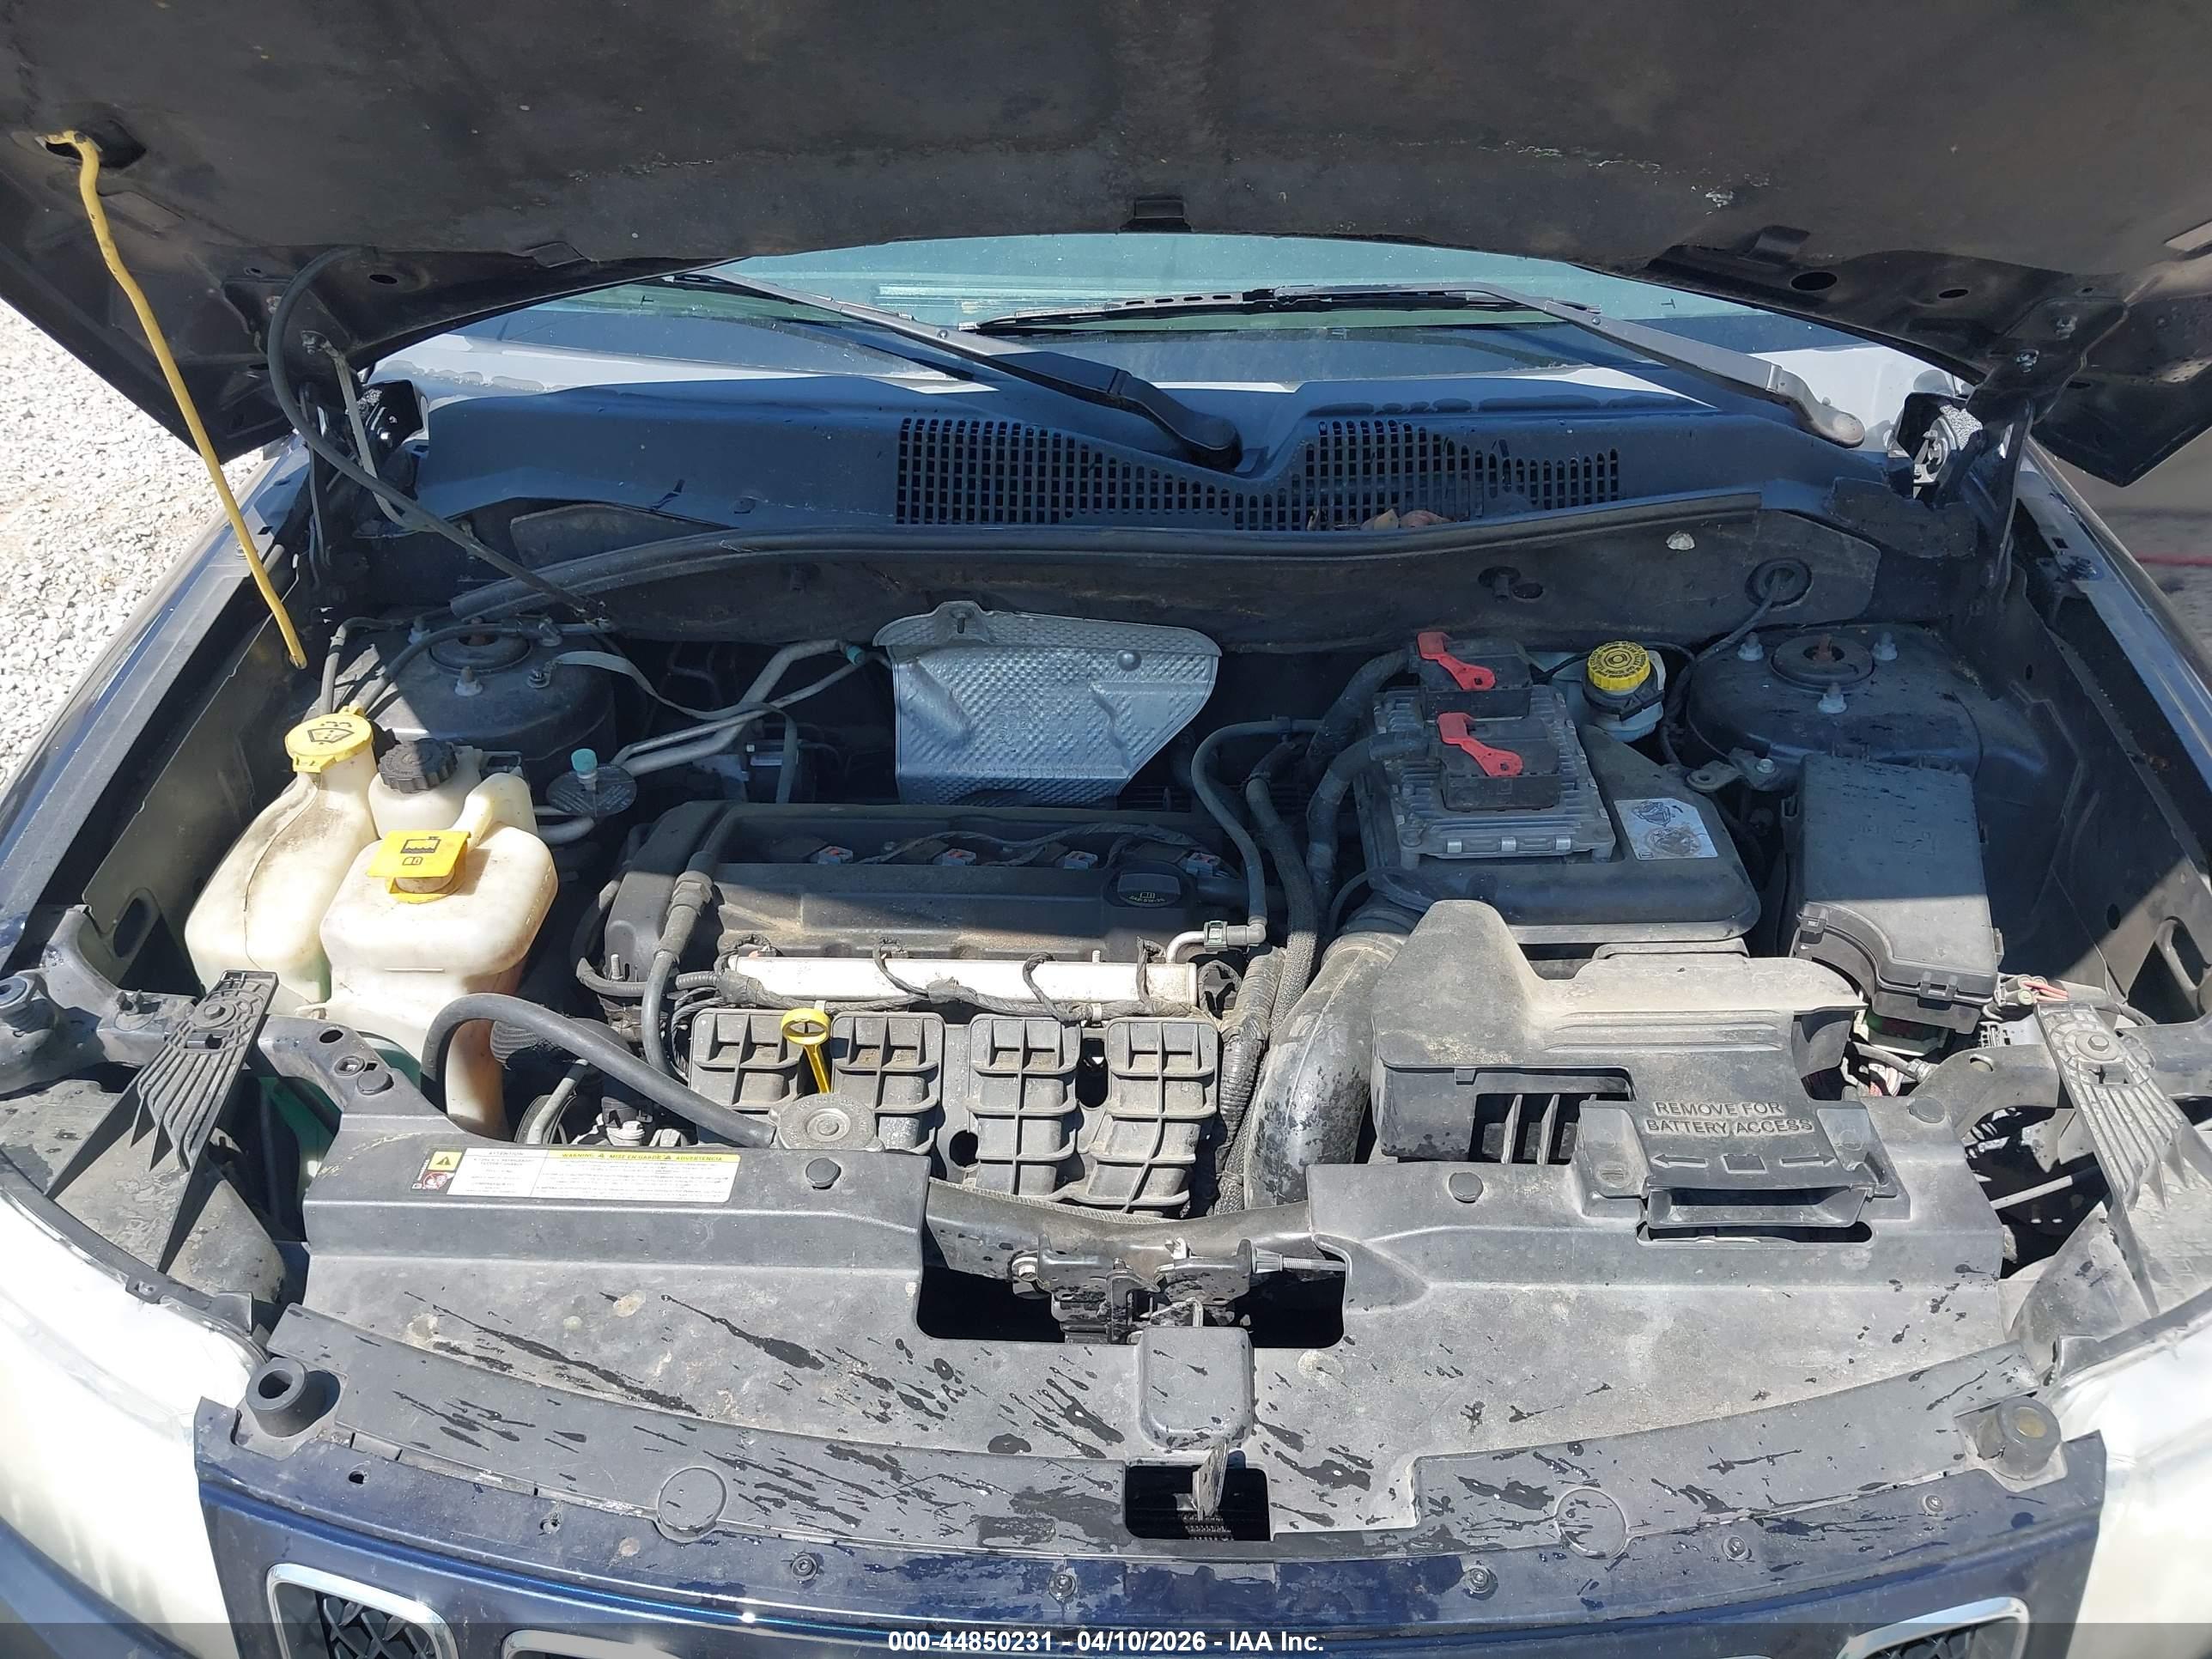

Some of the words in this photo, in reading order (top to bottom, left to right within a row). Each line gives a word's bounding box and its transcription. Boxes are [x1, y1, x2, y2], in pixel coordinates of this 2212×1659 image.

[1656, 1102, 1738, 1115] REMOVE
[1741, 1102, 1783, 1115] FOR
[1645, 1119, 1728, 1134] BATTERY
[1735, 1118, 1813, 1133] ACCESS
